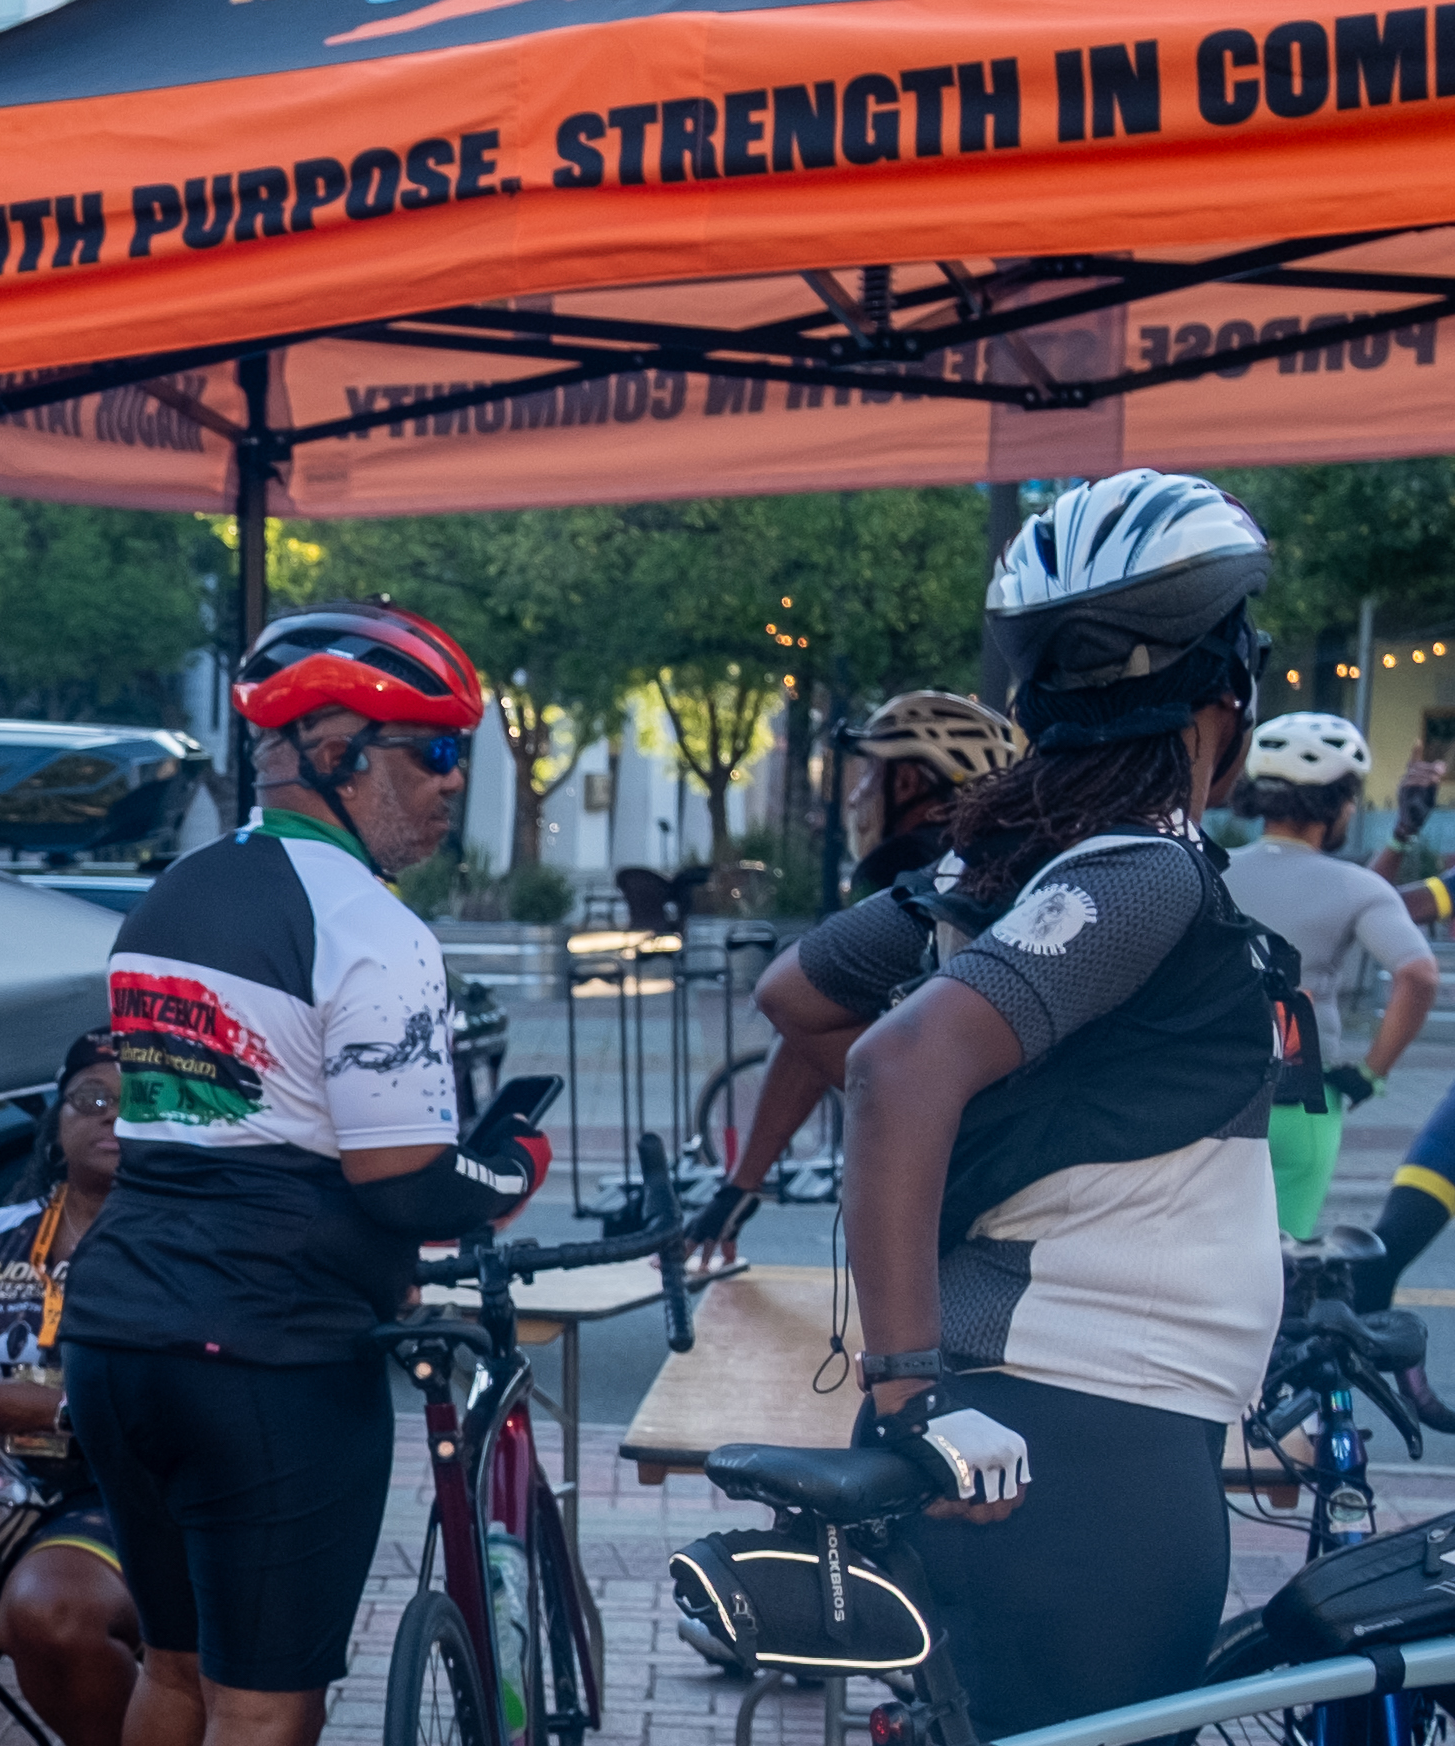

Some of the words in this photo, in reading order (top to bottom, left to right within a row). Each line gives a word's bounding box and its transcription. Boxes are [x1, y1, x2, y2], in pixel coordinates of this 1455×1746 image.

[128, 129, 521, 259] PURPOSE.
[554, 56, 1021, 190] STRENGTH
[1055, 39, 1160, 143] IN
[1195, 6, 1455, 127] COM
[825, 1524, 846, 1624] ROCKBROS
